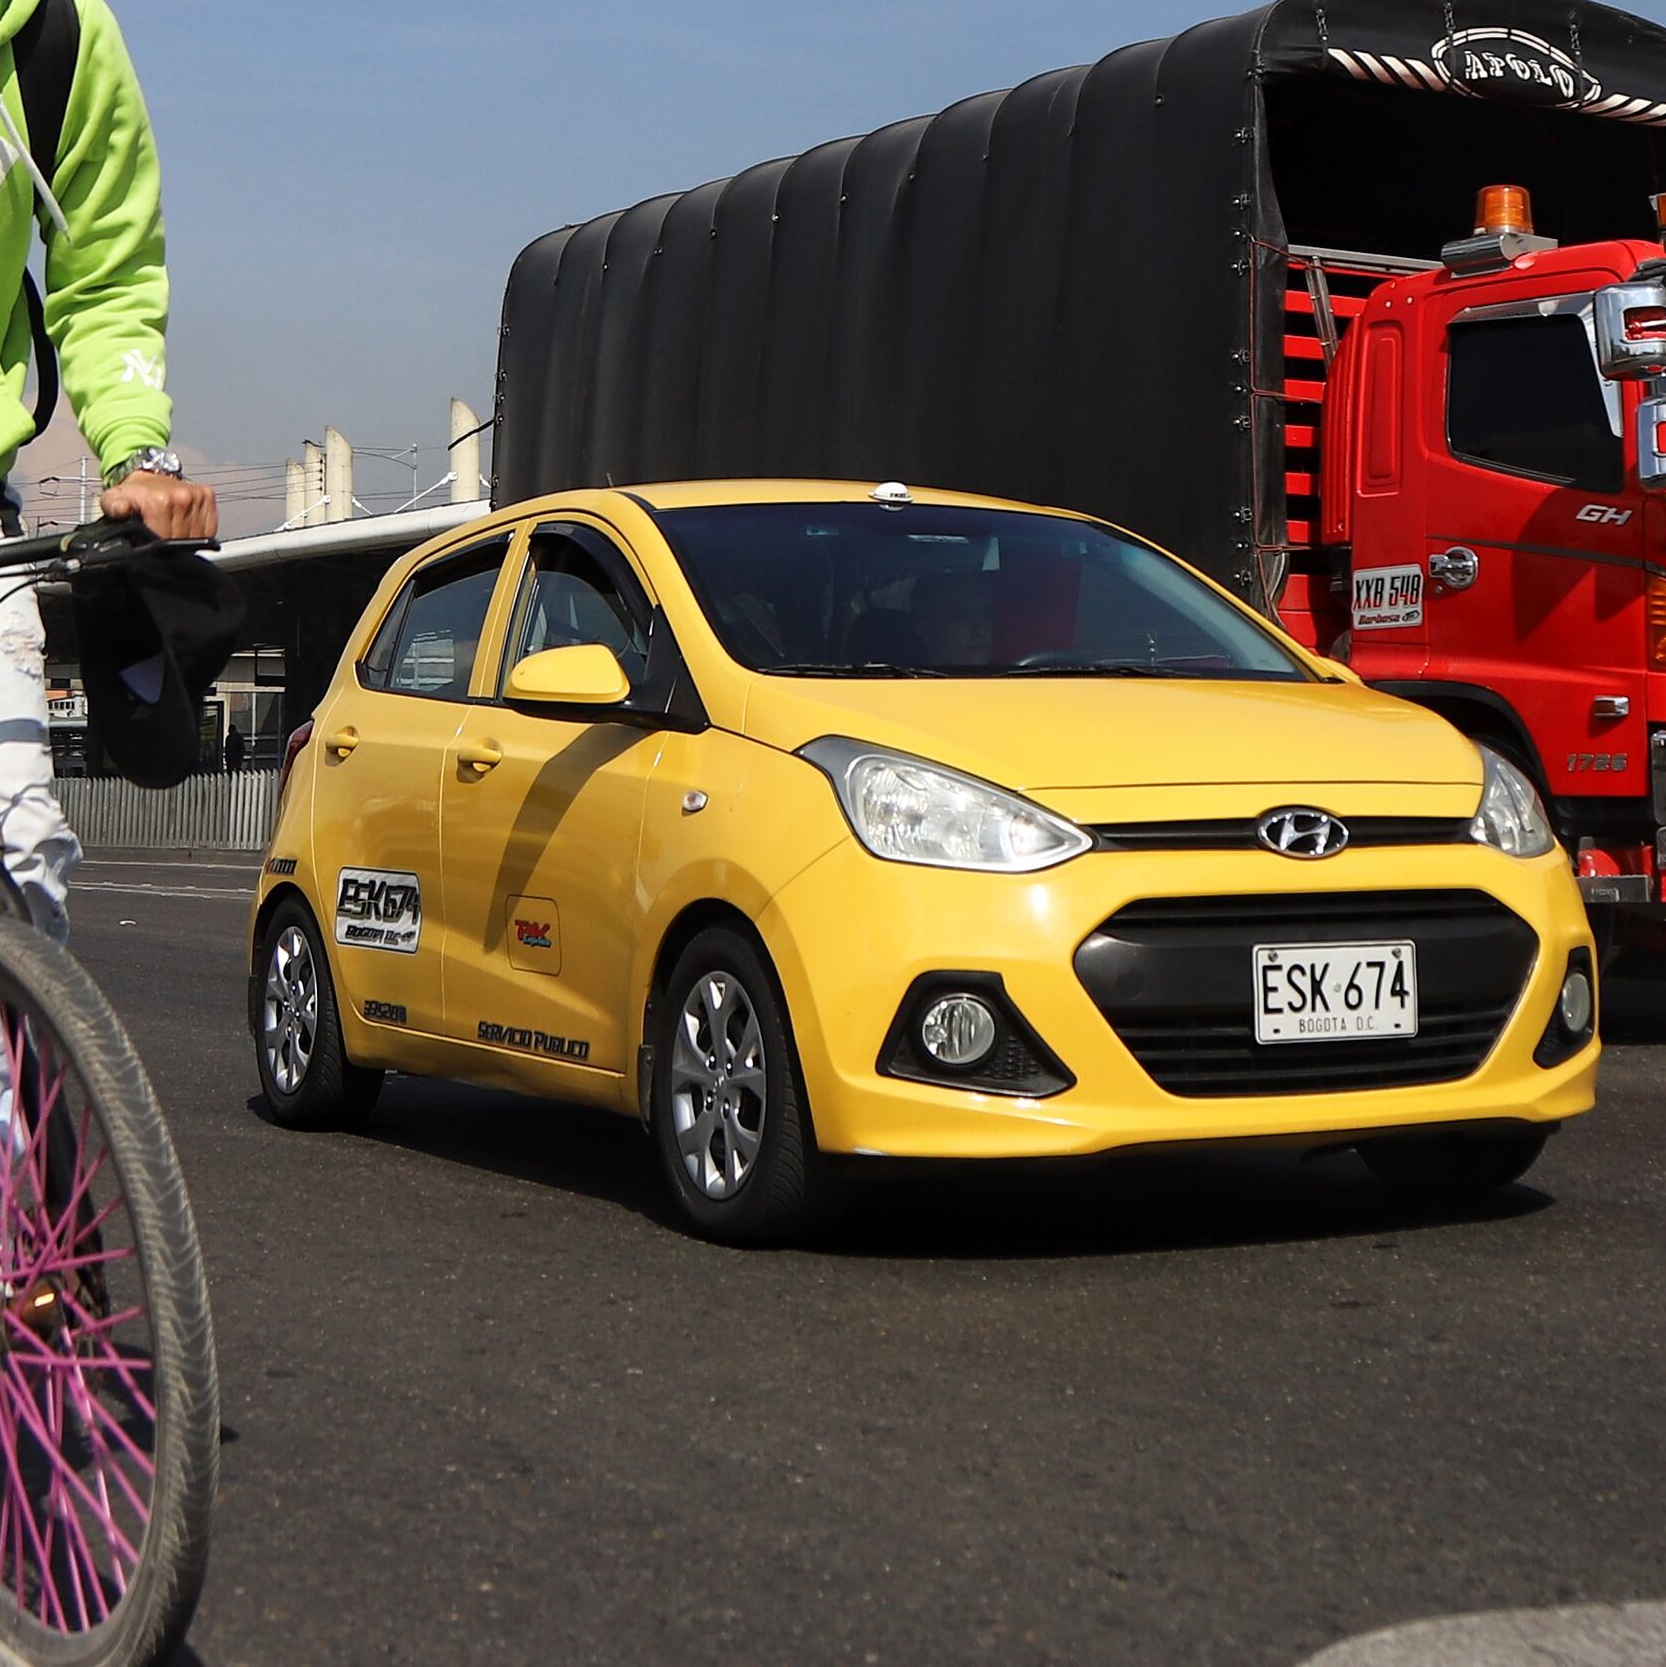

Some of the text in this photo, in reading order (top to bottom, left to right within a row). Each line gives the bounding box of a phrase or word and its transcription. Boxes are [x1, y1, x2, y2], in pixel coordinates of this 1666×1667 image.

[1464, 51, 1574, 98] APOLO
[1575, 504, 1633, 526] GH
[1354, 574, 1421, 610] XXB 548
[1566, 753, 1628, 772] 1726
[1262, 960, 1410, 1015] ESK 674
[1299, 1017, 1347, 1033] BOGOTA
